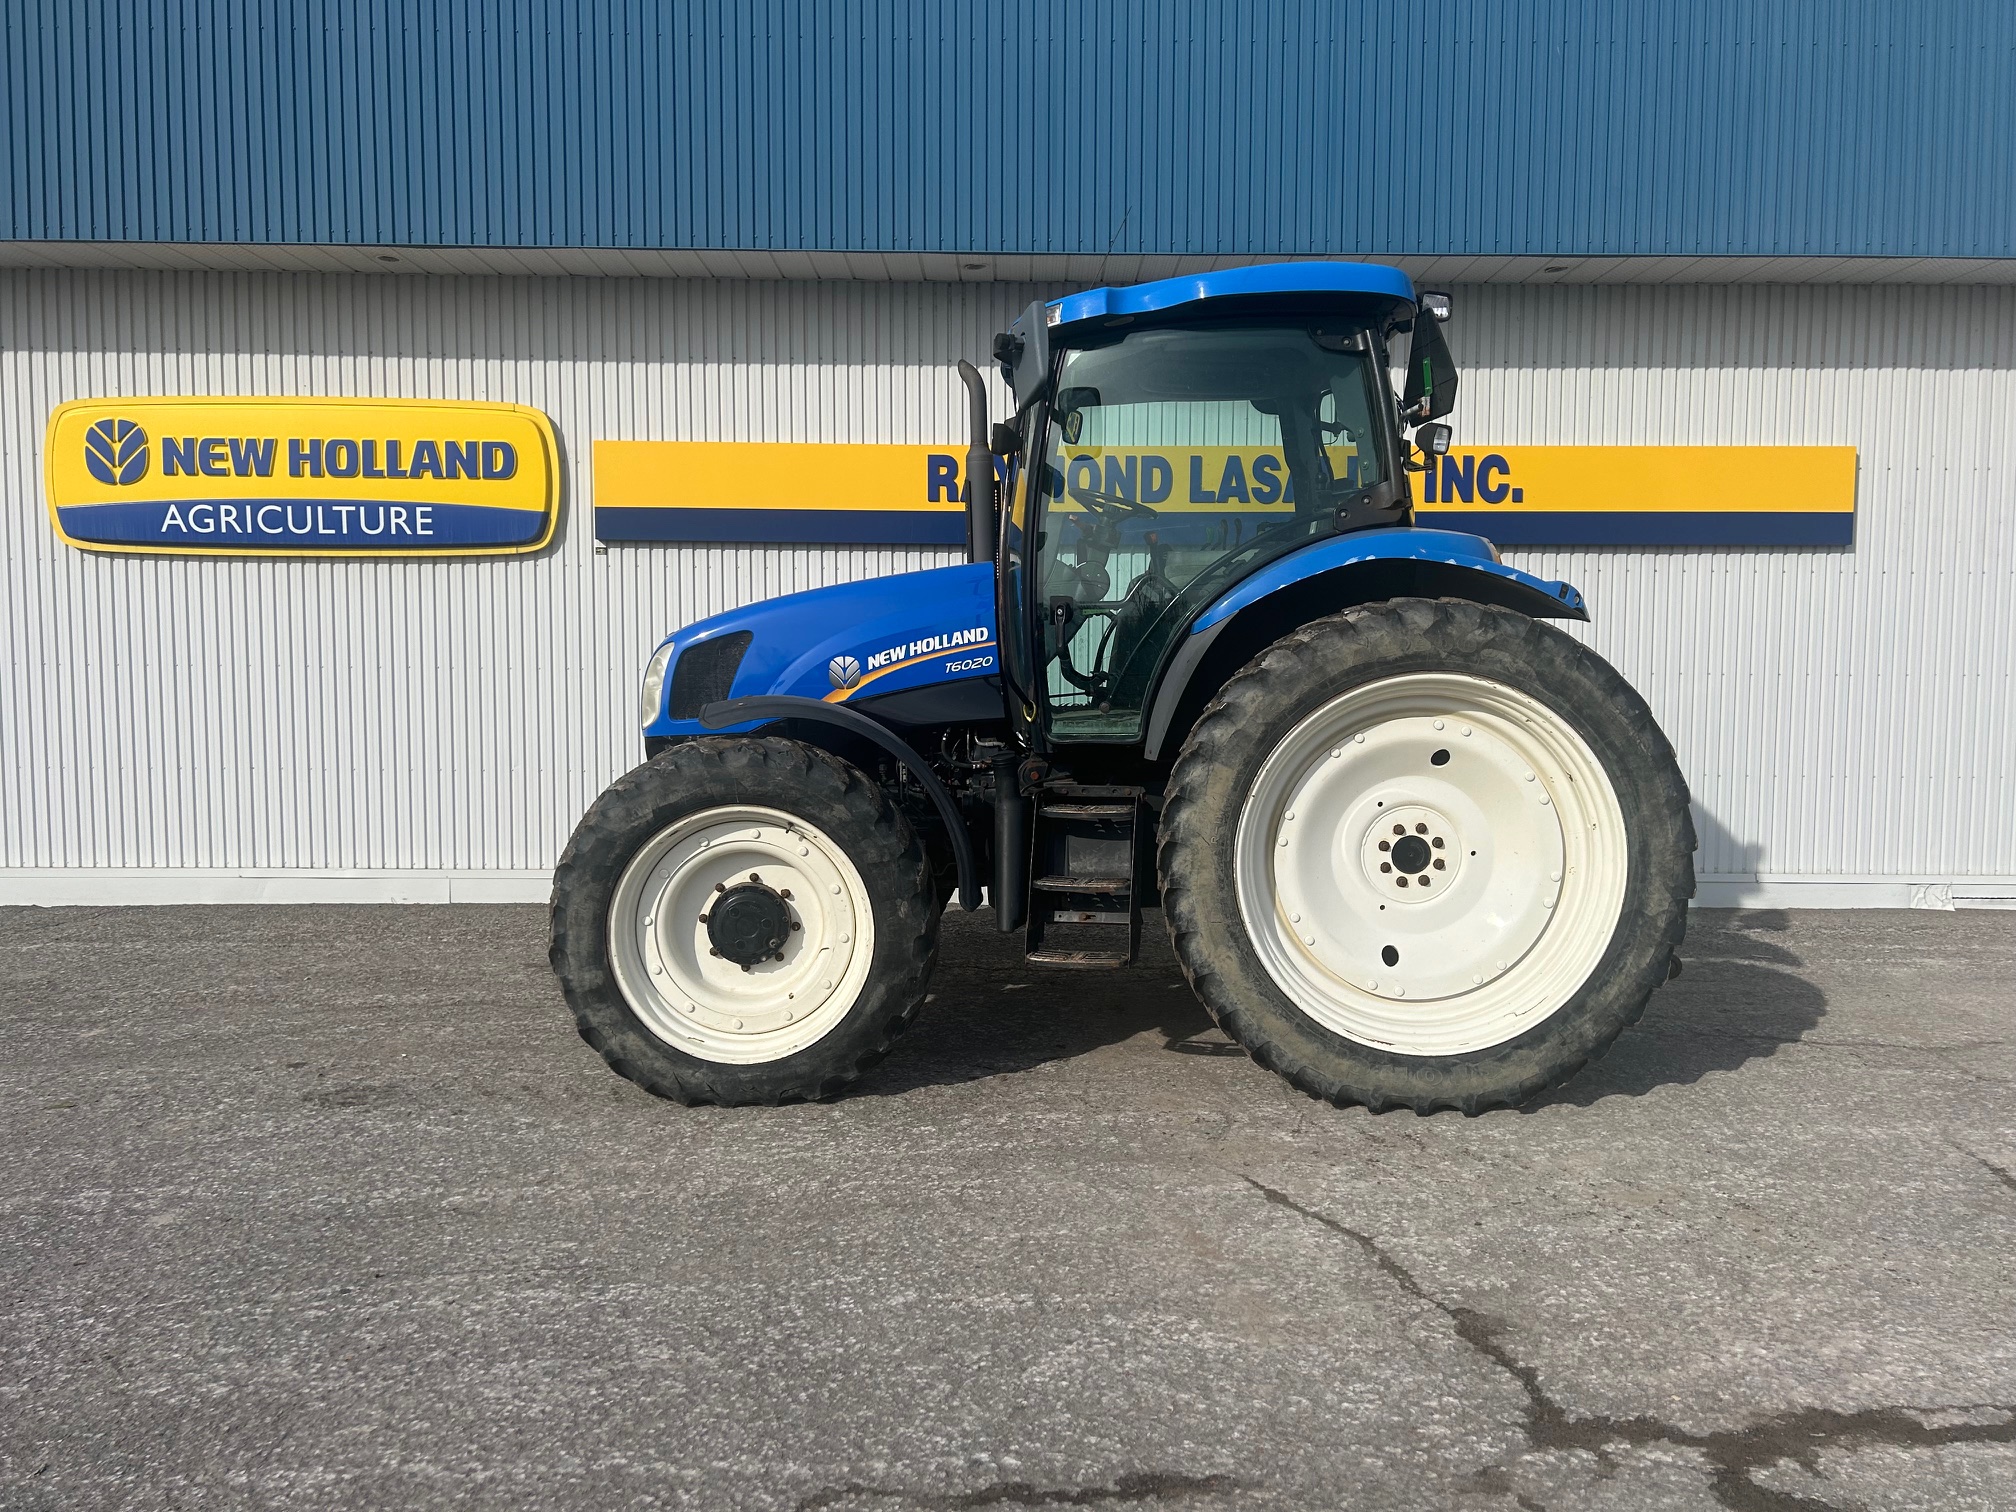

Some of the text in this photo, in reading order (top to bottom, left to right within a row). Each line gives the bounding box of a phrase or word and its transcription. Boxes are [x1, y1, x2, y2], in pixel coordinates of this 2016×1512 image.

[161, 437, 518, 481] NEW HOLLAND
[1424, 453, 1524, 505] INC.
[160, 503, 434, 536] AGRICULTURE
[867, 626, 989, 670] NEW HOLLAND
[945, 655, 994, 674] T6020
